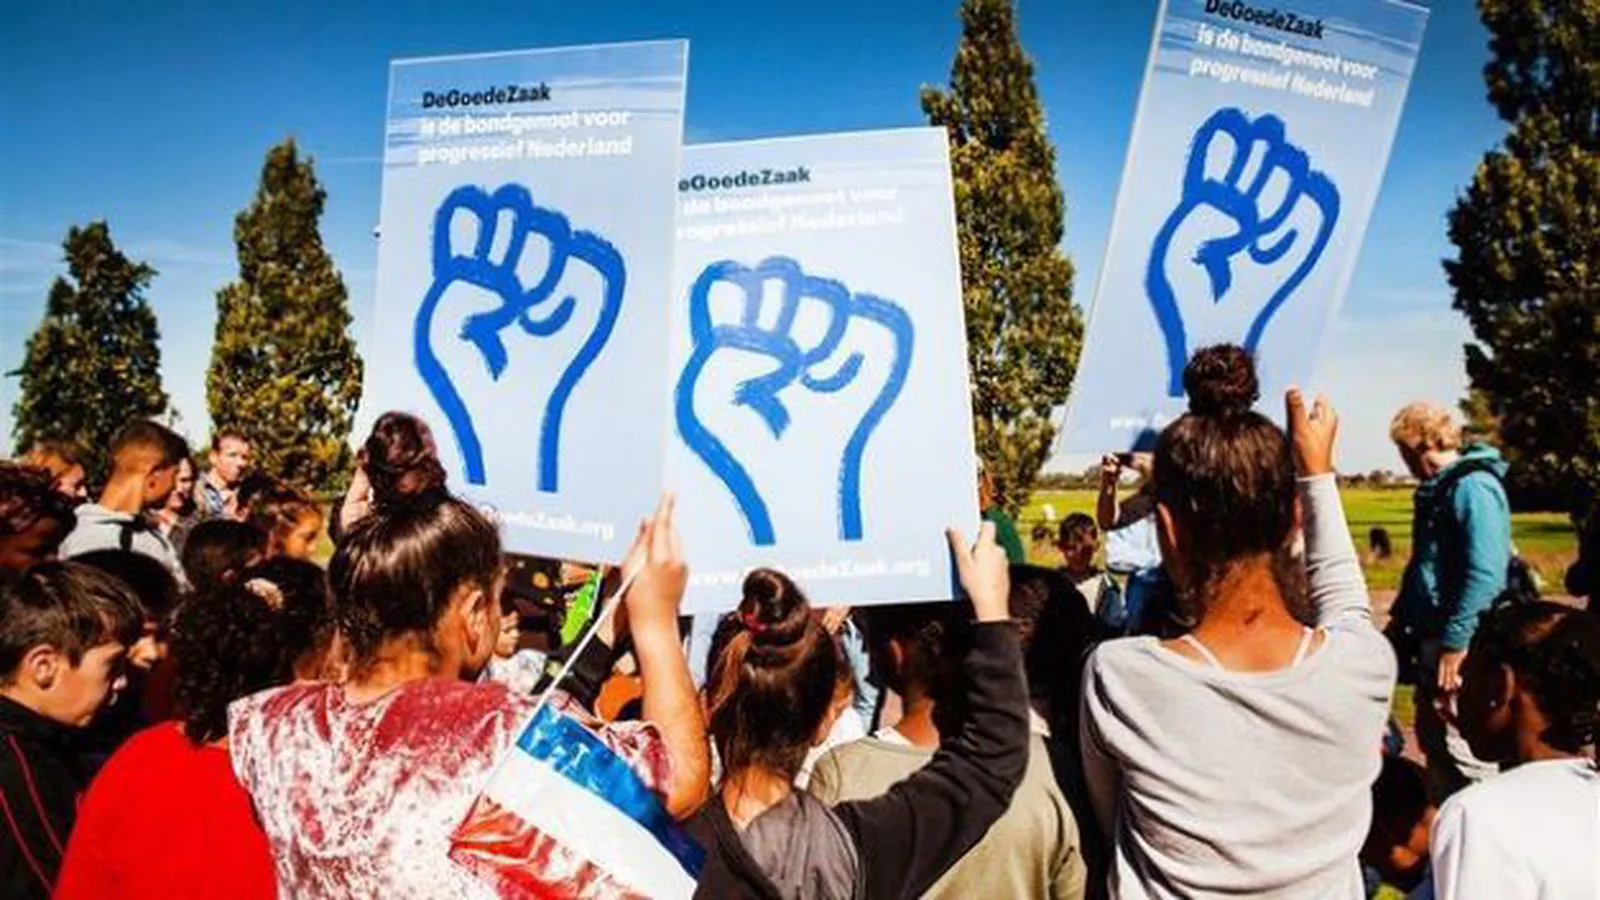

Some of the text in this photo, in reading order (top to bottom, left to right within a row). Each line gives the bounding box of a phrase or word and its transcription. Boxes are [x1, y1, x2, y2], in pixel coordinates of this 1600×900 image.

[1204, 0, 1325, 40] DeGoedeZaak
[1197, 23, 1379, 81] is de bondgenoot voor
[422, 81, 552, 109] DeGoedeZaak
[1190, 57, 1375, 107] progressief Nederland
[420, 109, 631, 135] is de bondgenoot voor
[418, 135, 632, 164] progressief Nederland
[678, 167, 811, 191] eGoedeZaak
[677, 206, 905, 242] rogressief Nederland
